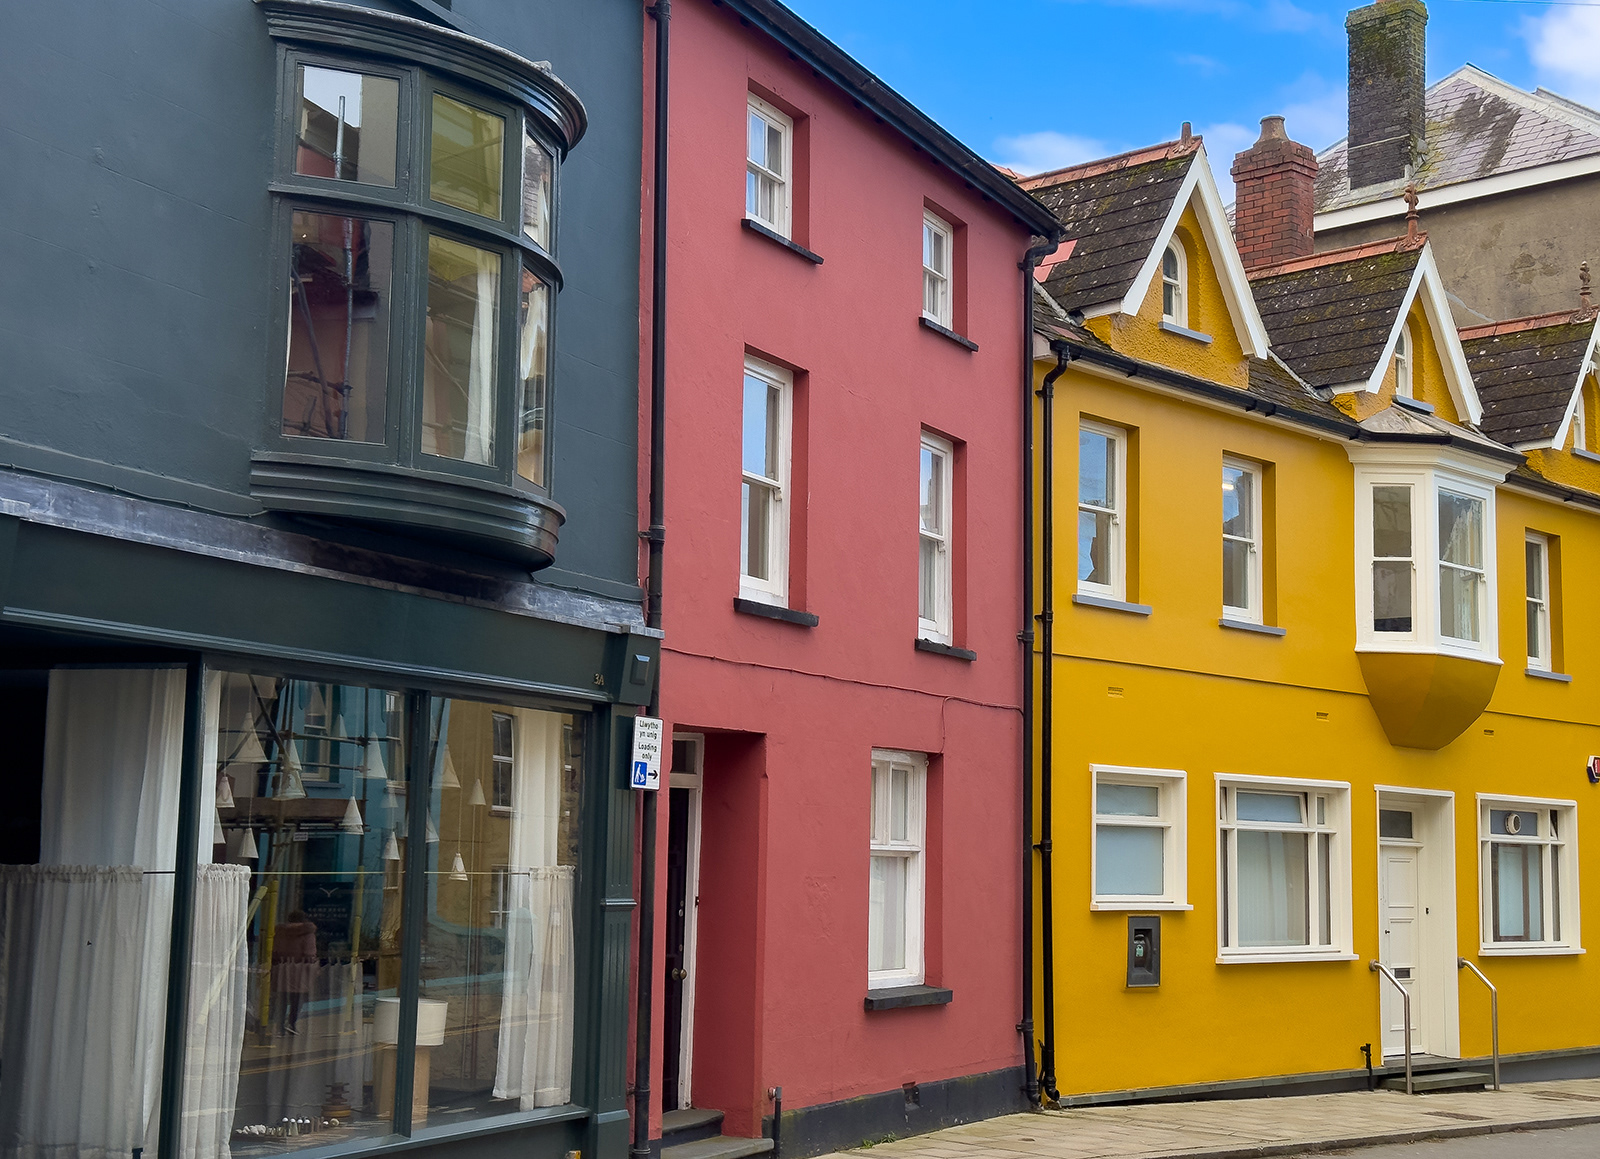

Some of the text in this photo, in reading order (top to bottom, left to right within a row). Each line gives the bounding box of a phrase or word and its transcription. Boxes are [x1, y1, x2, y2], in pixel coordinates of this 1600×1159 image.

[594, 674, 604, 685] 3A
[640, 720, 658, 729] Llwytho
[647, 731, 657, 740] unig
[639, 742, 657, 752] Loading
[641, 753, 652, 761] only
